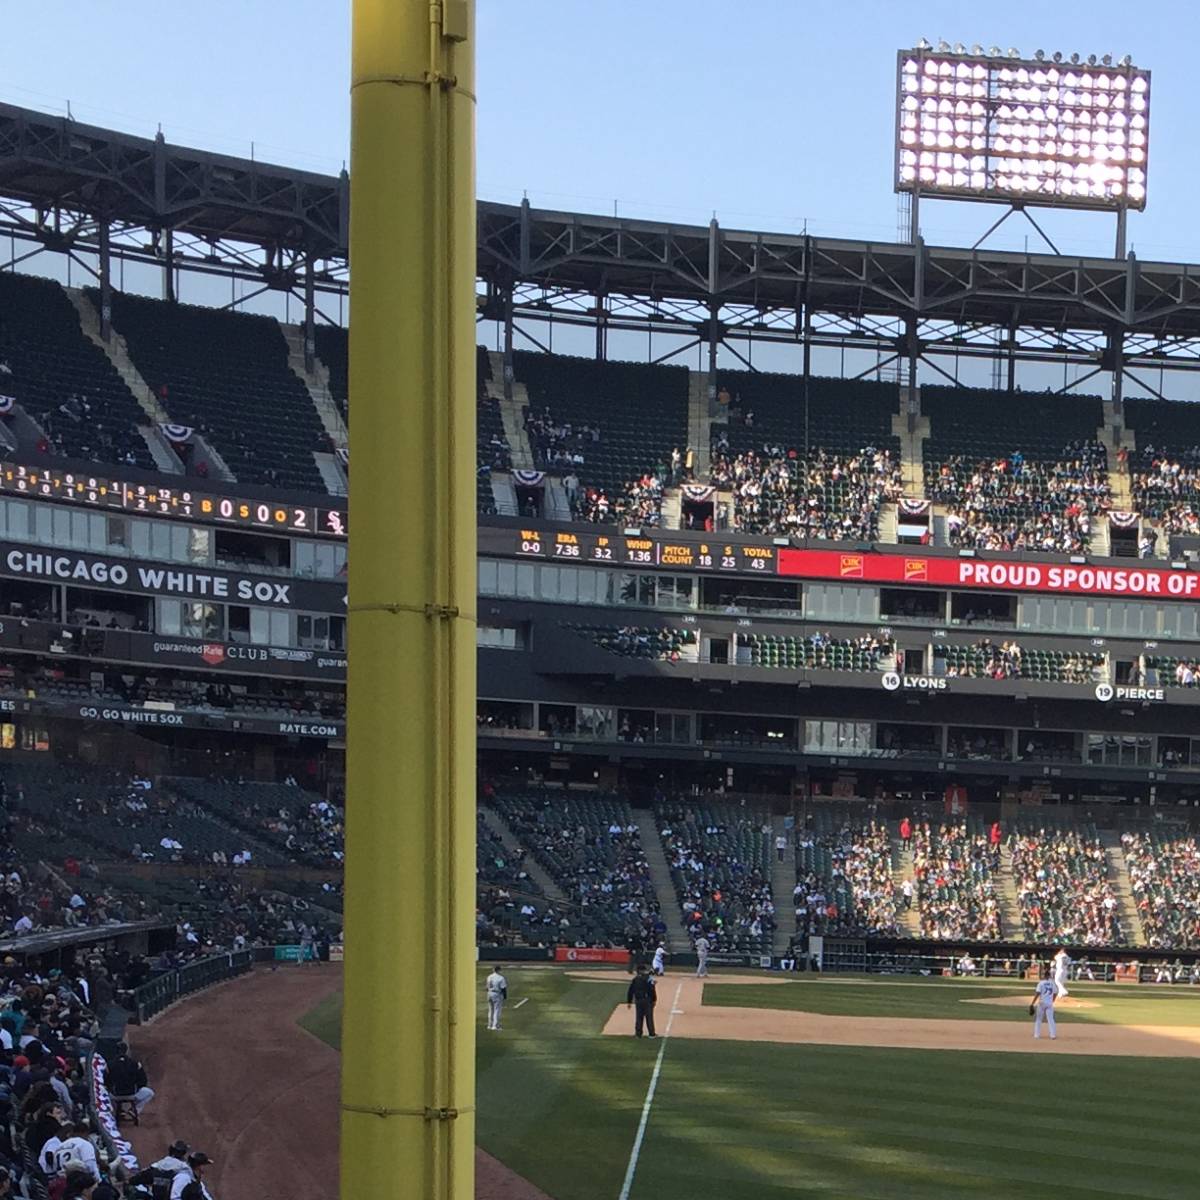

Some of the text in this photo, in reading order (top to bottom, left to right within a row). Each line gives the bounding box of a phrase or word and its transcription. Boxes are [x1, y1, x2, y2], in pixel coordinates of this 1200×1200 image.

[158, 489, 171, 498] 12
[202, 500, 212, 512] B
[220, 500, 232, 517] 0
[239, 506, 249, 518] S
[257, 505, 269, 522] 0
[293, 510, 306, 527] 2
[520, 530, 540, 541] W-L
[556, 533, 577, 544] ERA
[522, 542, 541, 553] 0-0
[598, 537, 608, 547] IP
[626, 540, 652, 550] WHIP
[556, 544, 580, 557] 7.36
[595, 548, 612, 560] 3.2
[664, 546, 690, 556] PITCH
[701, 545, 708, 554] B
[725, 546, 732, 556] S
[743, 548, 773, 558] TOTAL
[628, 550, 651, 562] 1.36
[661, 555, 693, 565] COUNT
[699, 555, 712, 566] 18
[722, 557, 736, 568] 25
[751, 558, 765, 570] 43
[6, 550, 290, 604] CHICAGO WHITE SOX
[960, 562, 1041, 586] PROUD
[1048, 570, 1160, 594] SPONSOR
[1171, 575, 1198, 595] OF
[227, 647, 268, 660] CLUB
[886, 675, 947, 689] 16 LYONS
[1099, 687, 1164, 700] 19 PIERCE
[80, 706, 183, 724] GO, GO WHITE SOX
[279, 723, 337, 736] RATE.COM
